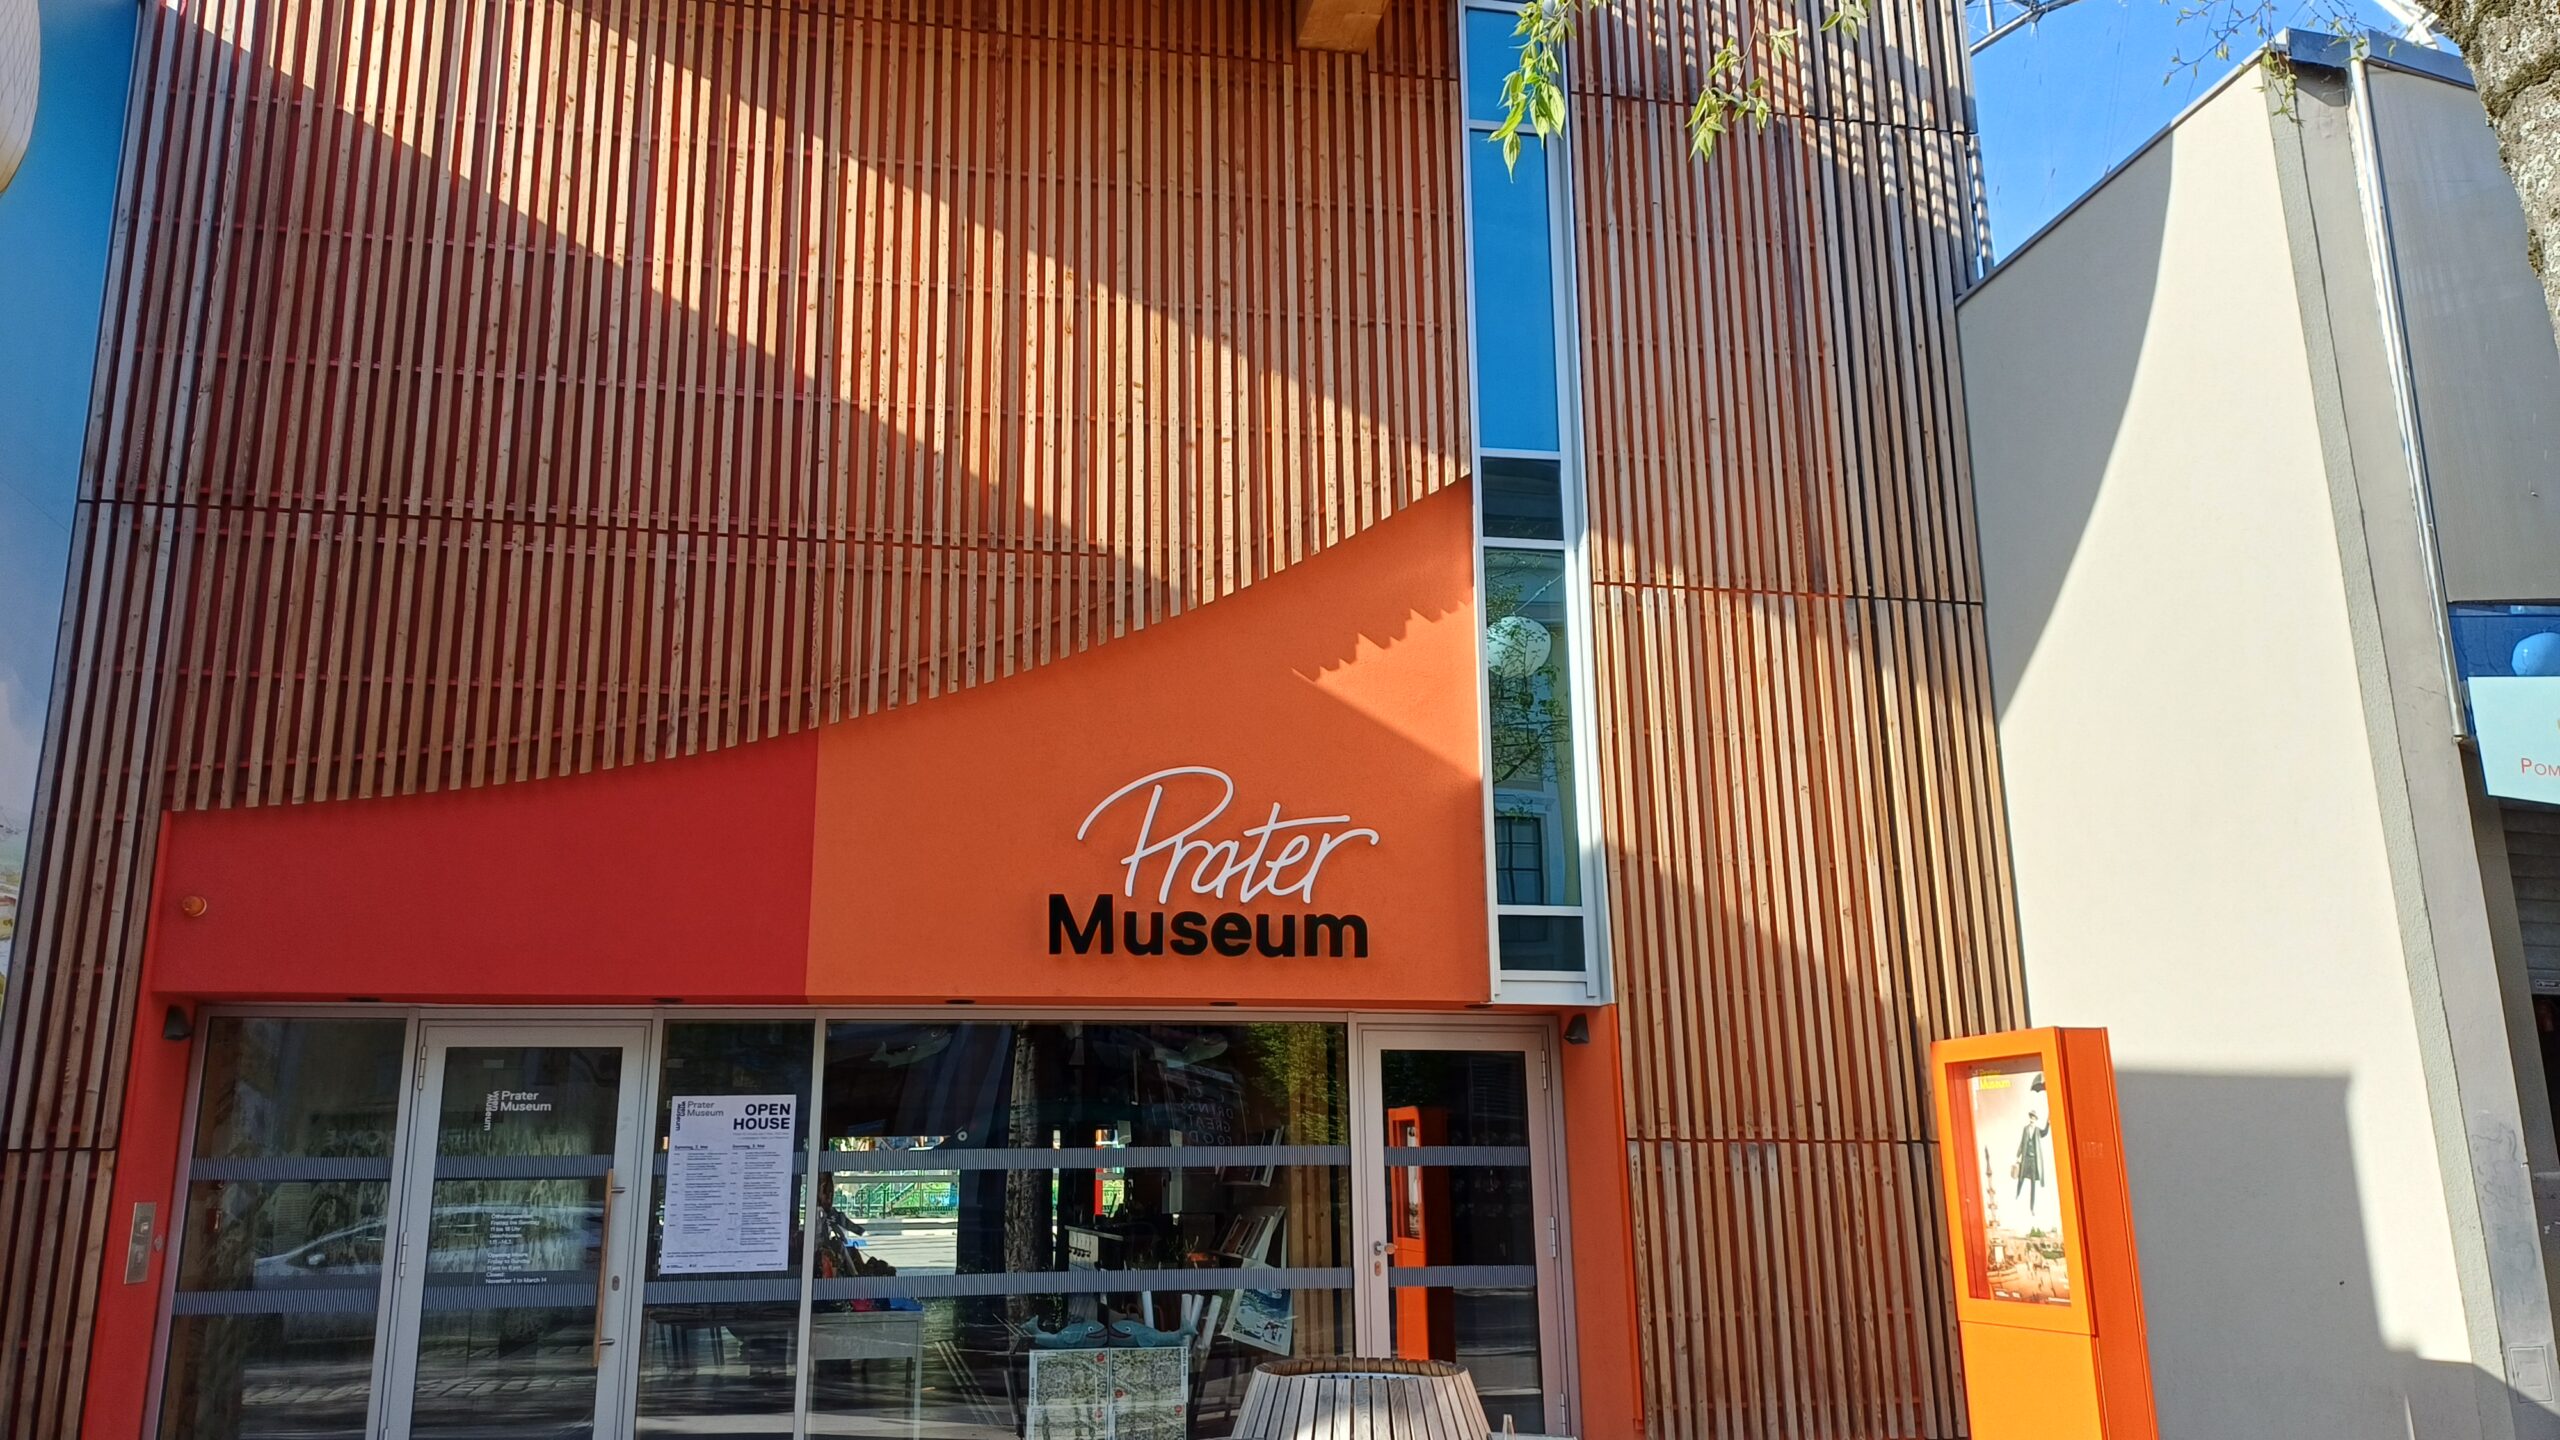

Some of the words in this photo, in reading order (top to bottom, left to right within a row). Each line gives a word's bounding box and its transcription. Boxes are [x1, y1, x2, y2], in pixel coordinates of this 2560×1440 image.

[1077, 765, 1379, 904] Prater
[1048, 893, 1368, 958] Museum
[501, 1090, 539, 1101] Prater
[500, 1101, 552, 1111] Museum
[687, 1101, 715, 1109] Prater
[745, 1103, 791, 1116] OPEN
[687, 1109, 724, 1117] Museum
[733, 1117, 791, 1130] HOUSE
